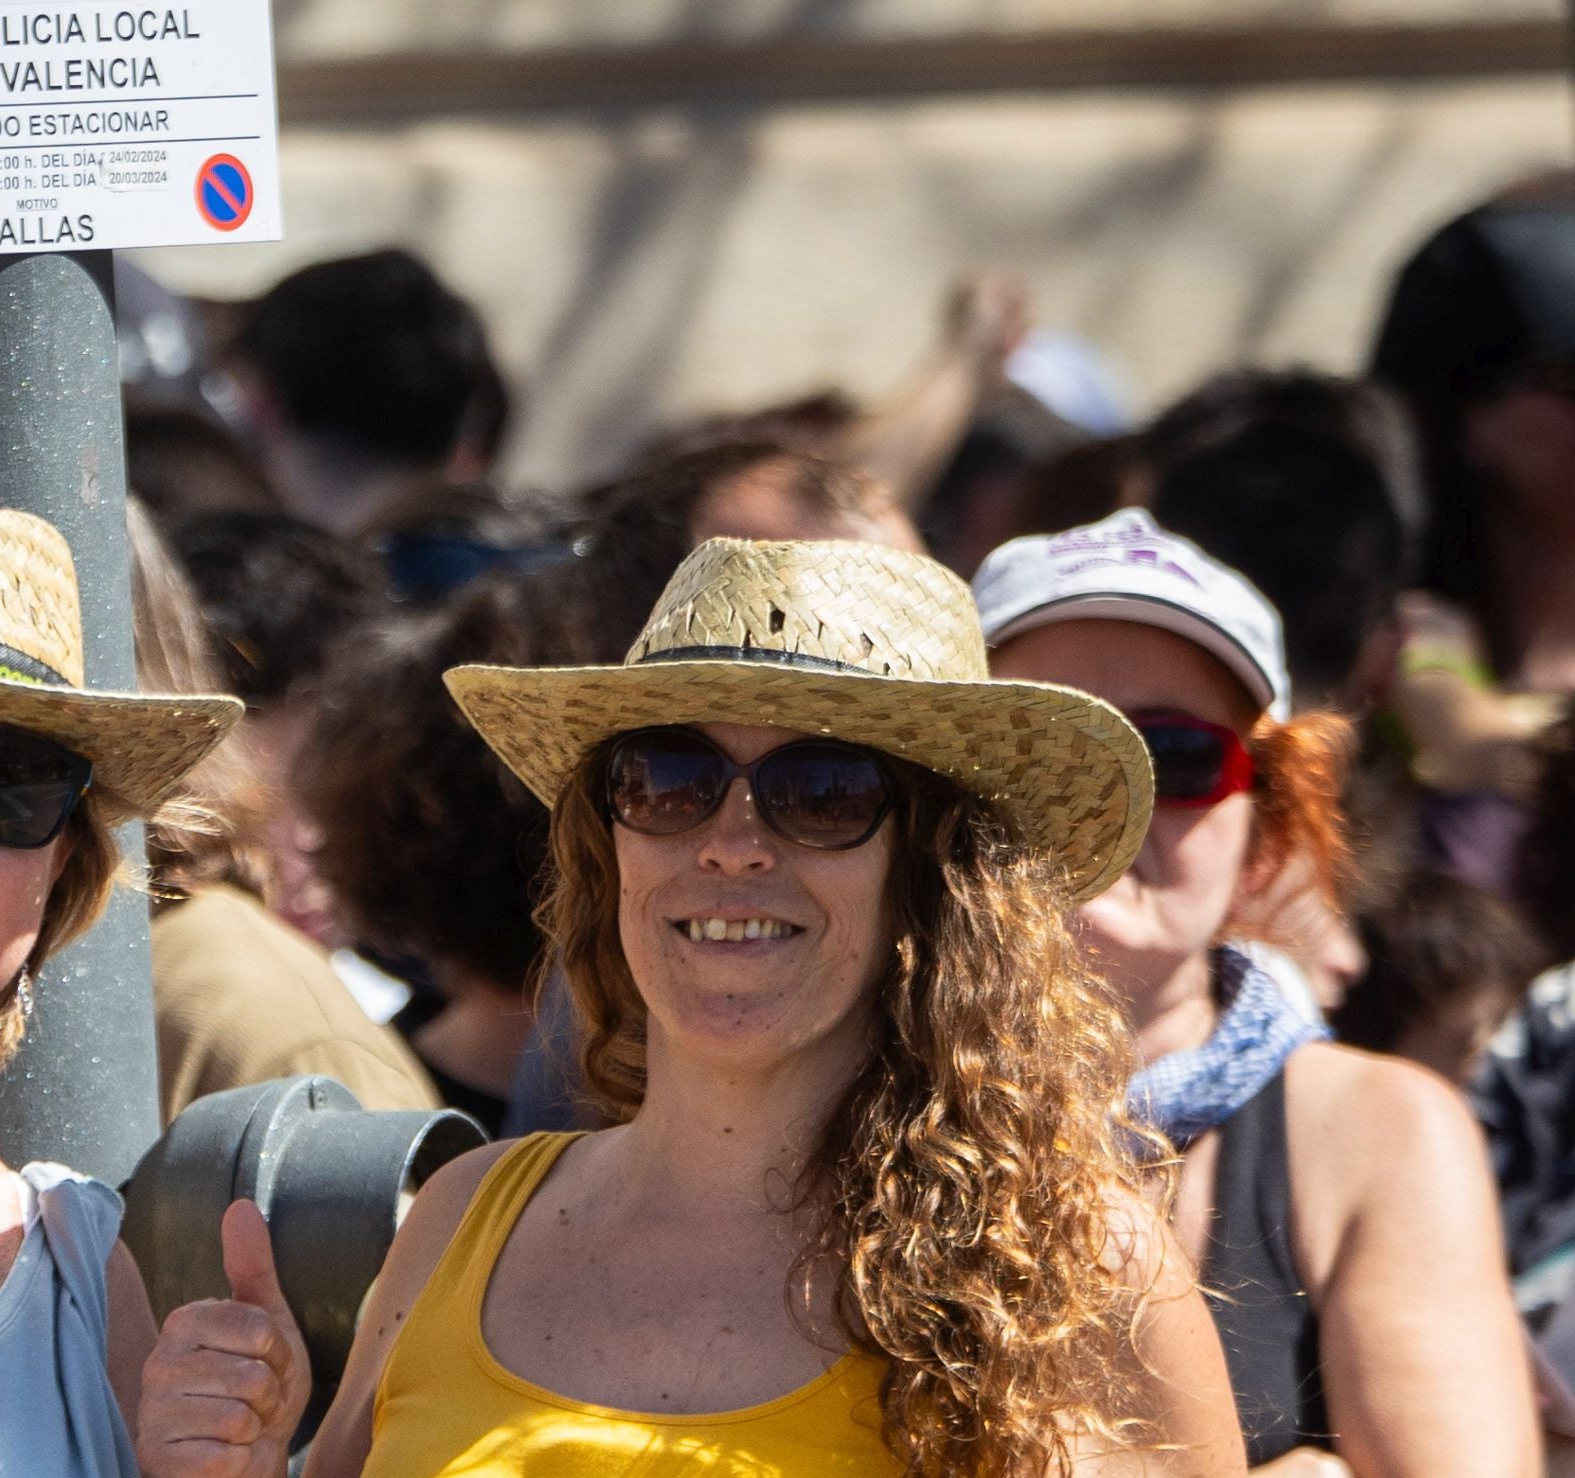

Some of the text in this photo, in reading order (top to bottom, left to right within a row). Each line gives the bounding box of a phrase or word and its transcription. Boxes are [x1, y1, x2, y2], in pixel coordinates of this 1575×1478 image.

[95, 9, 200, 43] LOCAL
[0, 57, 161, 92] VALENCIA
[29, 110, 171, 137] ESTACIONAR
[41, 154, 69, 168] DEL
[109, 150, 167, 164] 24/02/2024
[41, 173, 69, 188] DEL
[73, 170, 96, 187] DÍA
[108, 171, 168, 185] 20/03/2024
[16, 198, 58, 211] MOTIVO
